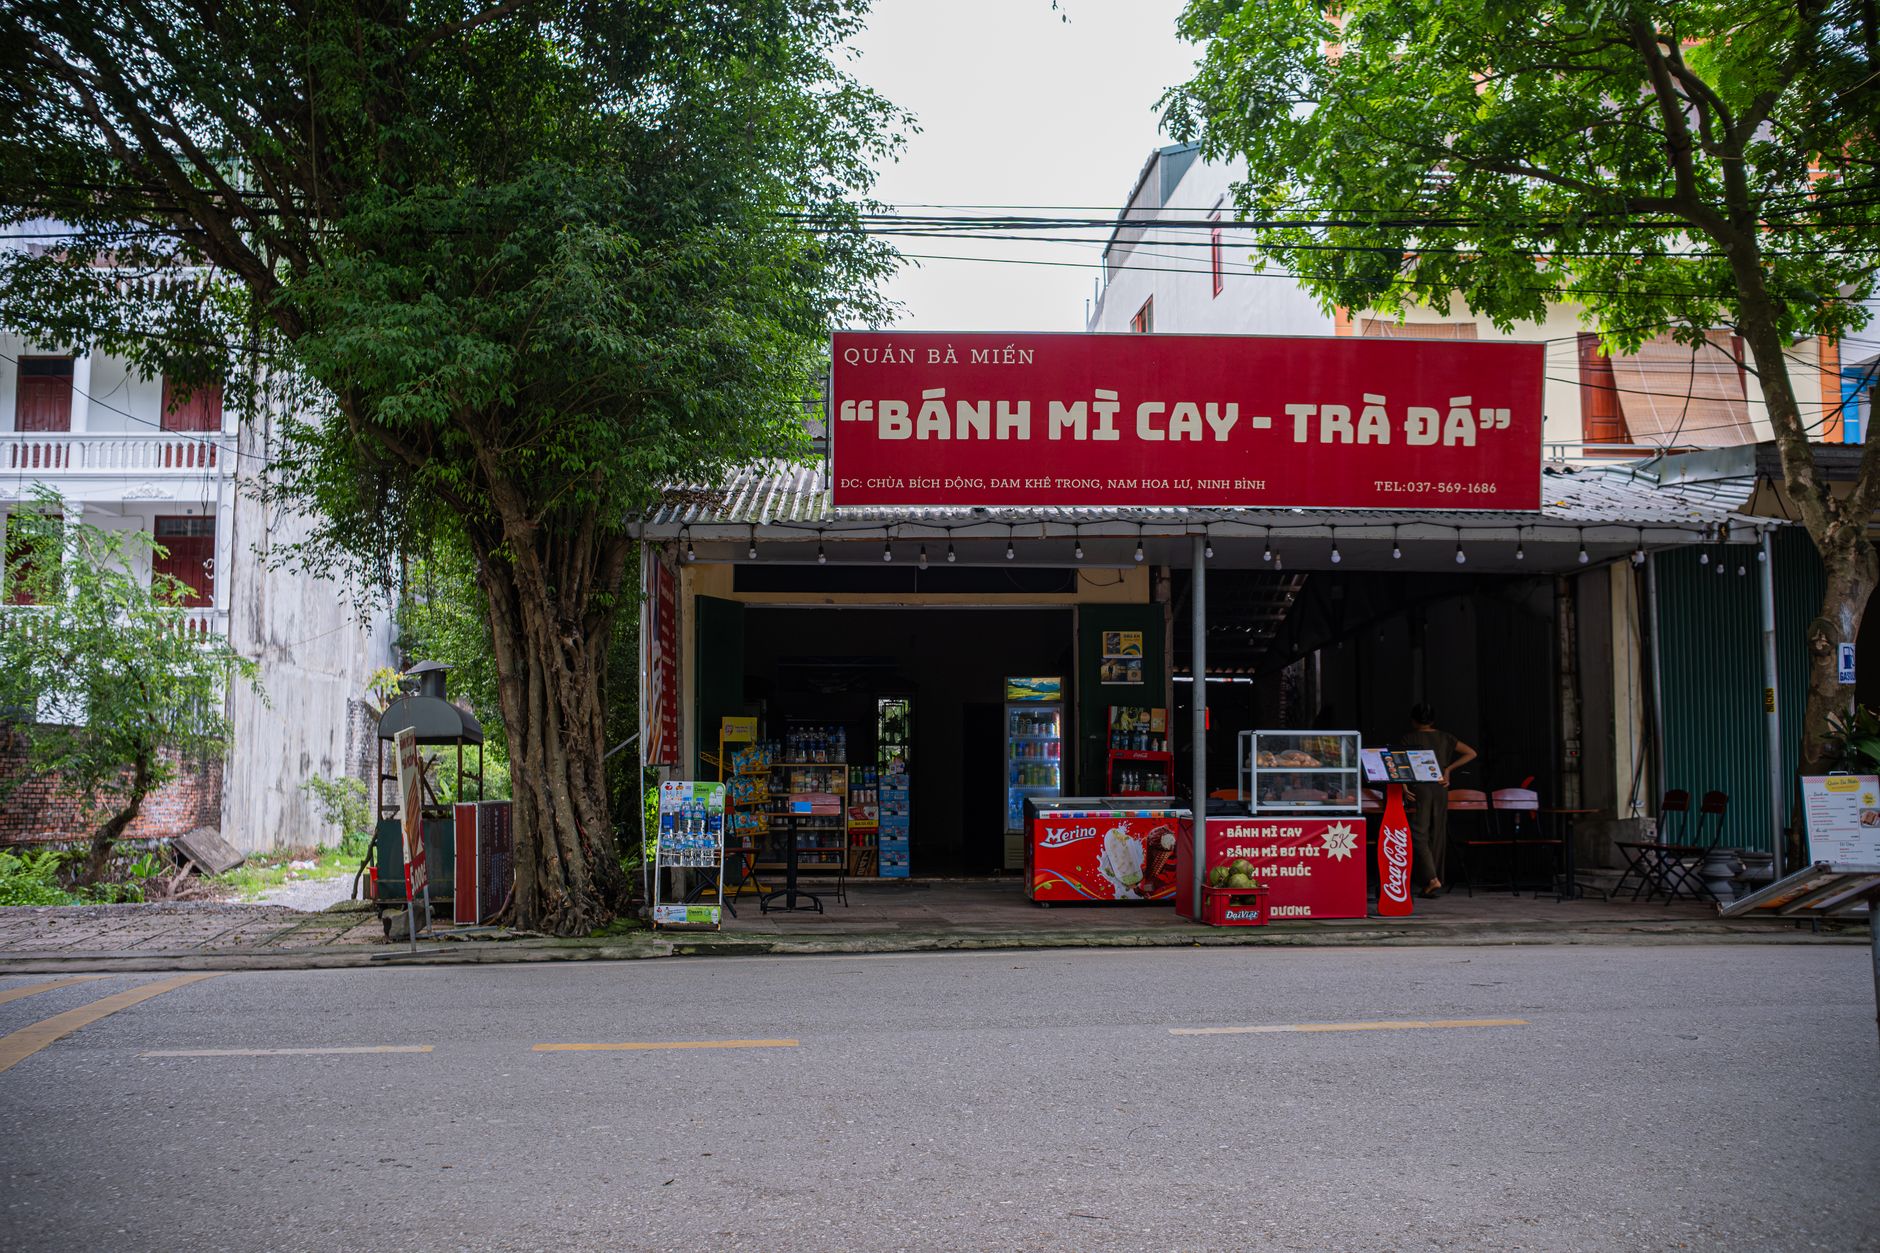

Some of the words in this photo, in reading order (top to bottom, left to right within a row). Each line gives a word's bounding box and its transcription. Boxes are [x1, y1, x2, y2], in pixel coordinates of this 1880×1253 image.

[844, 343, 916, 366] QUÁN
[927, 344, 959, 364] BÀ
[970, 343, 1035, 365] MIẾN
[1048, 388, 1120, 441] MÌ
[1136, 401, 1239, 442] CAY
[1252, 416, 1272, 429] -
[1285, 393, 1391, 445] TRÀ
[840, 478, 863, 488] ĐC:
[866, 476, 904, 489] CHÙA
[909, 476, 940, 489] BÍCH
[944, 476, 986, 490] ĐỘNG,
[990, 478, 1021, 488] ĐAM
[1024, 476, 1051, 489] KHÊ
[1055, 479, 1103, 490] TRONG,
[1107, 479, 1138, 489] NAM
[1141, 479, 1170, 489] HOA
[1173, 478, 1193, 491] LƯ,
[1197, 479, 1231, 490] NINH
[1234, 477, 1266, 490] BÌNH
[1374, 481, 1497, 494] TEL:037-569-1686
[1043, 825, 1097, 845] Merino
[1226, 825, 1259, 838] BÁNH
[1261, 825, 1278, 838] MÌ
[1280, 827, 1303, 838] CAY
[1329, 833, 1350, 850] 5K
[1226, 844, 1259, 858] BÁNH
[1261, 844, 1278, 858] MÌ
[1280, 847, 1297, 858] BƠ
[1261, 864, 1278, 877] MÌ
[1280, 862, 1312, 877] RUỐC
[1270, 906, 1312, 916] DƯƠNG
